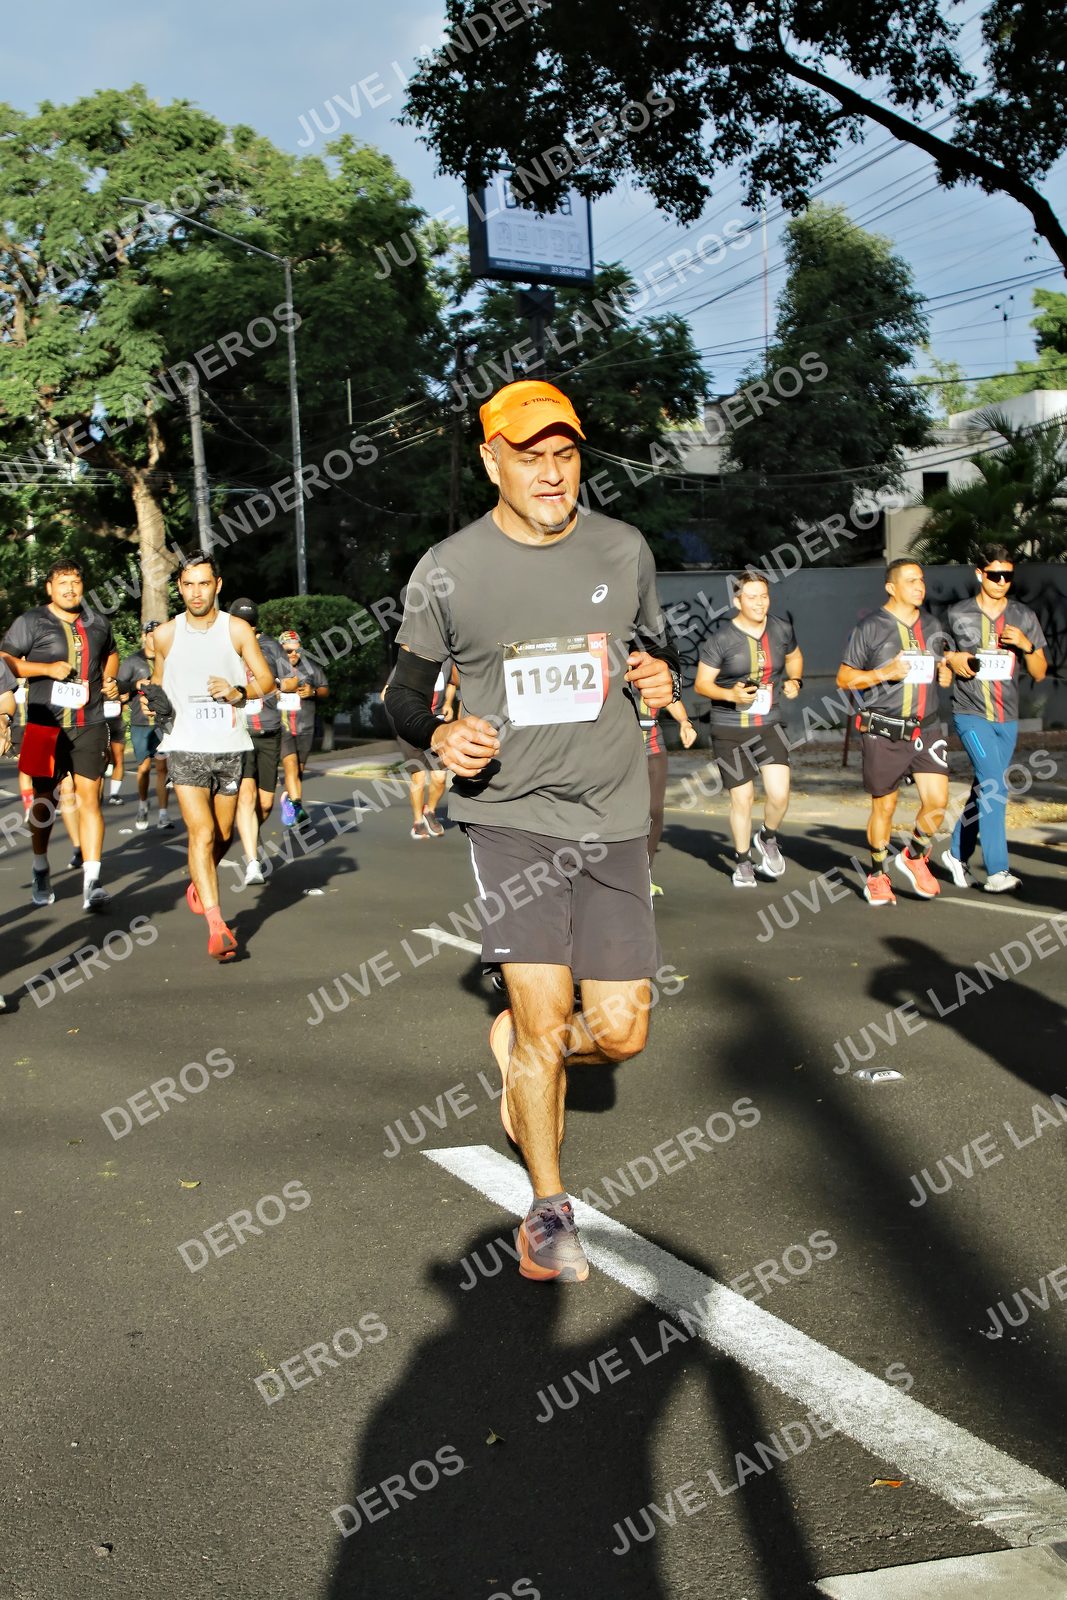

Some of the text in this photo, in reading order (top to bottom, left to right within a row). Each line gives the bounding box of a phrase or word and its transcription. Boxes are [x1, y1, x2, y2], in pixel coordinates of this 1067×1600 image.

[511, 663, 597, 695] 11942
[58, 686, 81, 697] 8718
[196, 707, 224, 719] 8131
